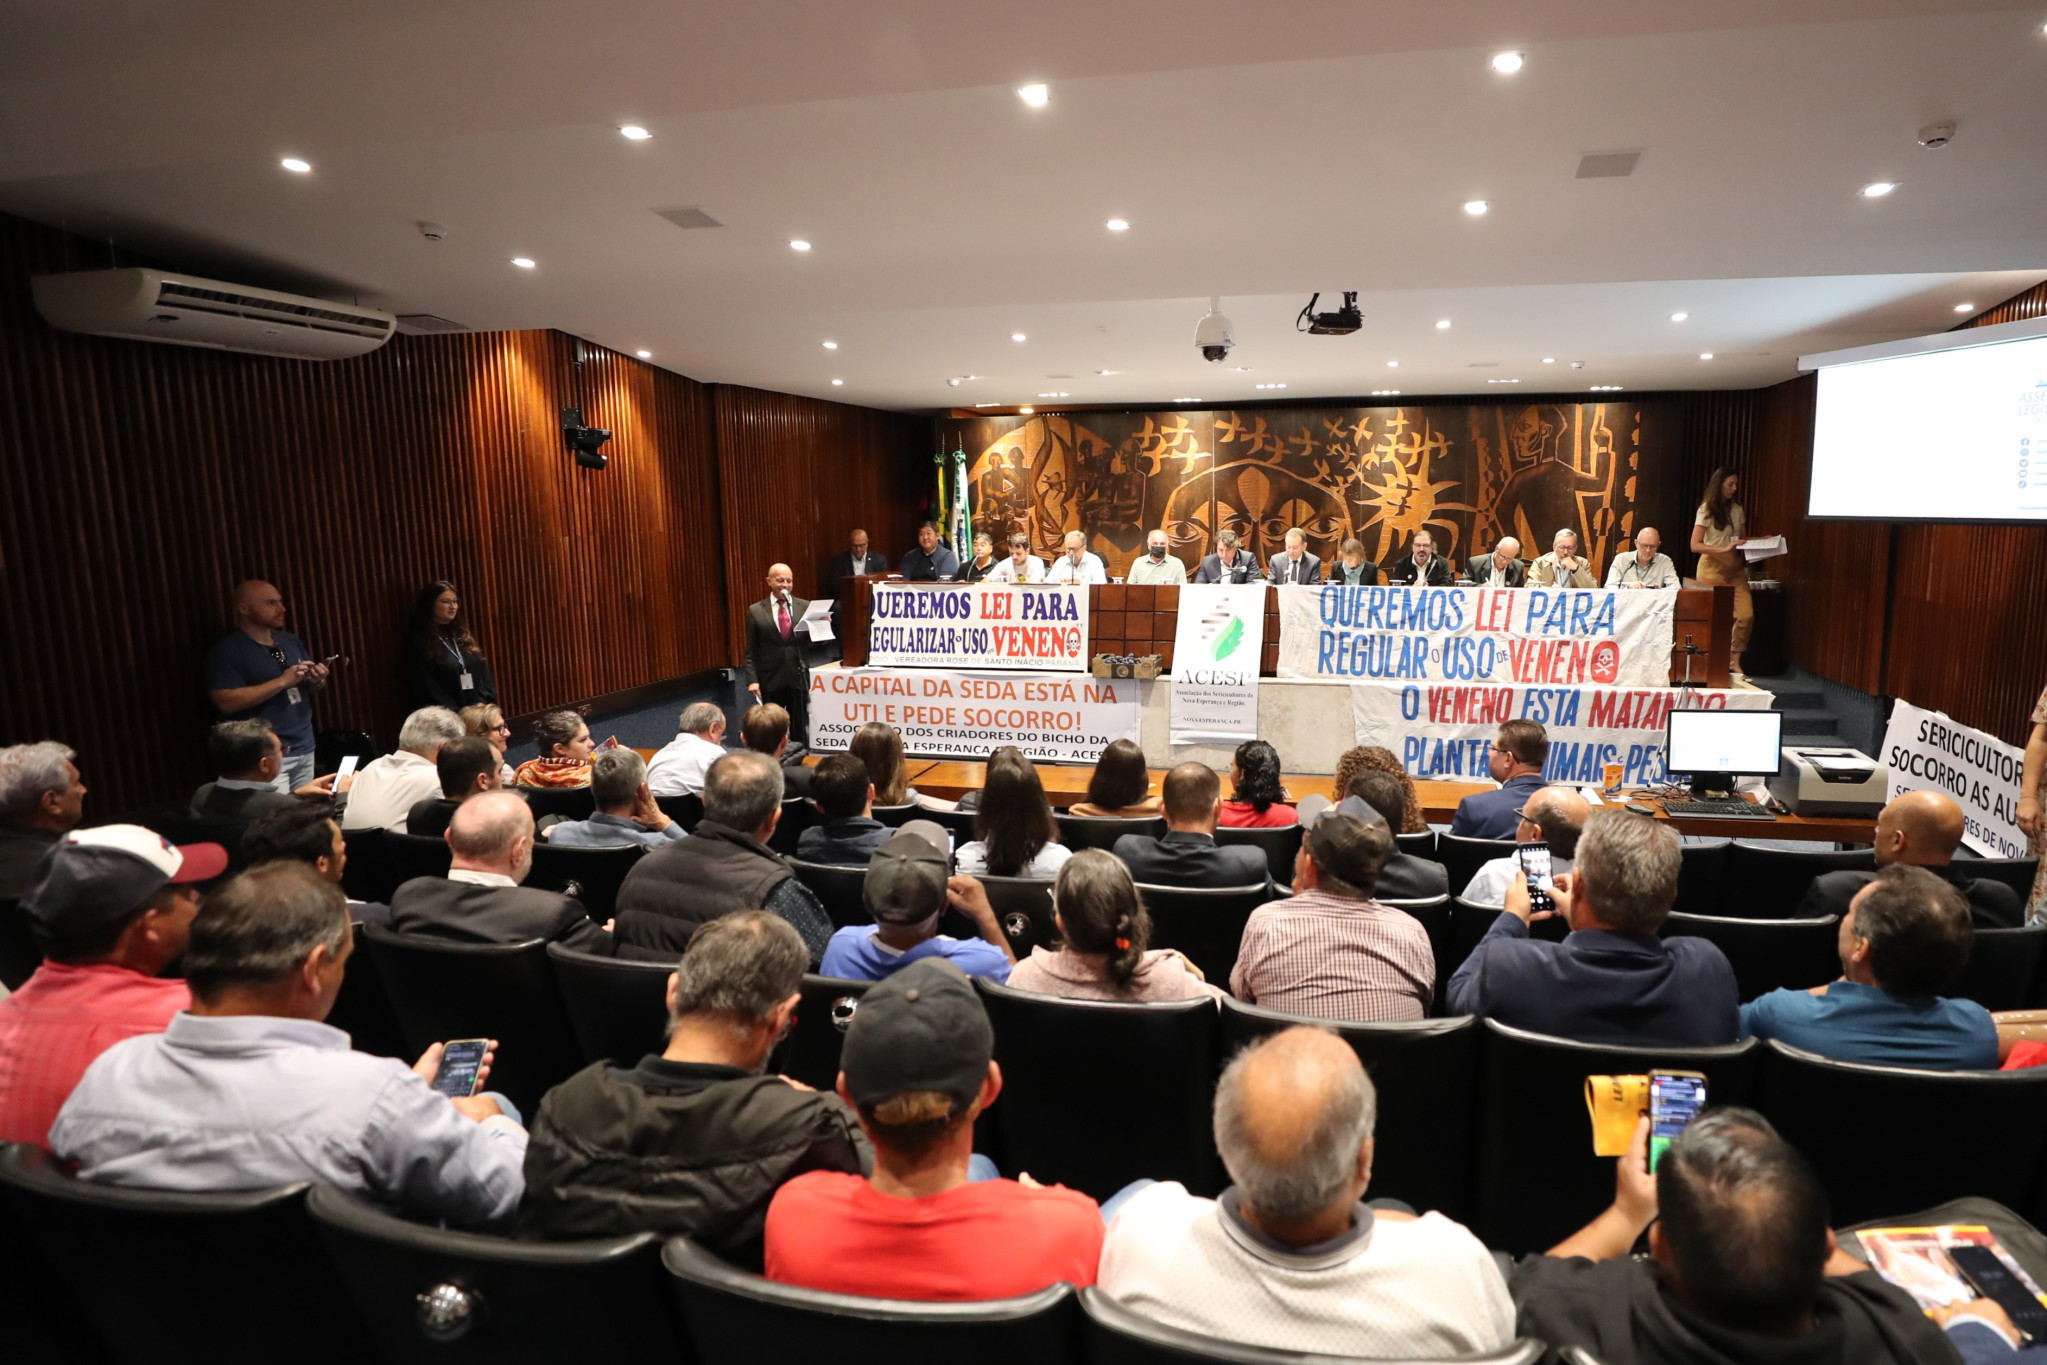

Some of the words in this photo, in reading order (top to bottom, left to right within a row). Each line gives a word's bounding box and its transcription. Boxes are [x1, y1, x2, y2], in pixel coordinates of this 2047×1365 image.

[980, 592, 1013, 620] LEI
[1021, 592, 1079, 621] PARA
[1320, 585, 1466, 631] QUEREMOS
[1474, 588, 1515, 632] LEI
[1525, 590, 1616, 636] PARA
[869, 626, 956, 654] EGULARIZAR
[962, 628, 988, 655] USO
[894, 656, 945, 664] VEREADORA
[946, 657, 969, 665] ROSE
[984, 658, 1013, 666] SANTO
[1317, 630, 1429, 680] REGULAR
[1442, 635, 1496, 681] USO
[1496, 650, 1509, 664] DE
[1508, 637, 1620, 685] VENENO
[811, 674, 826, 693] A
[831, 675, 917, 697] CAPITAL
[923, 679, 953, 698] DA
[960, 680, 1017, 701] SEDA
[1024, 679, 1077, 703] ESTÁ
[1084, 684, 1118, 704] NA
[1178, 669, 1251, 687] ACESP
[844, 703, 878, 722] UTI
[885, 705, 896, 722] E
[903, 706, 957, 725] PEDE
[963, 708, 1083, 731] SOCORRO!
[1401, 684, 1420, 721] O
[1427, 685, 1514, 724] VENENO
[1519, 687, 1581, 727] ESTA
[819, 723, 902, 735] ASSOCO
[906, 727, 933, 737] DOS
[937, 728, 1013, 741] CRIADORES
[1017, 732, 1038, 742] DO
[1042, 733, 1085, 745] BICHO
[1089, 735, 1109, 745] DA
[815, 737, 848, 748] SEDA
[914, 742, 991, 756] ESPERANÇA
[1070, 750, 1103, 761] ACES
[1403, 735, 1492, 778] PLANTA
[1917, 719, 2024, 789] SERICICULTOR
[1888, 745, 1967, 798] SOCORRO
[1970, 780, 1990, 811] AS
[1982, 827, 1997, 848] DE
